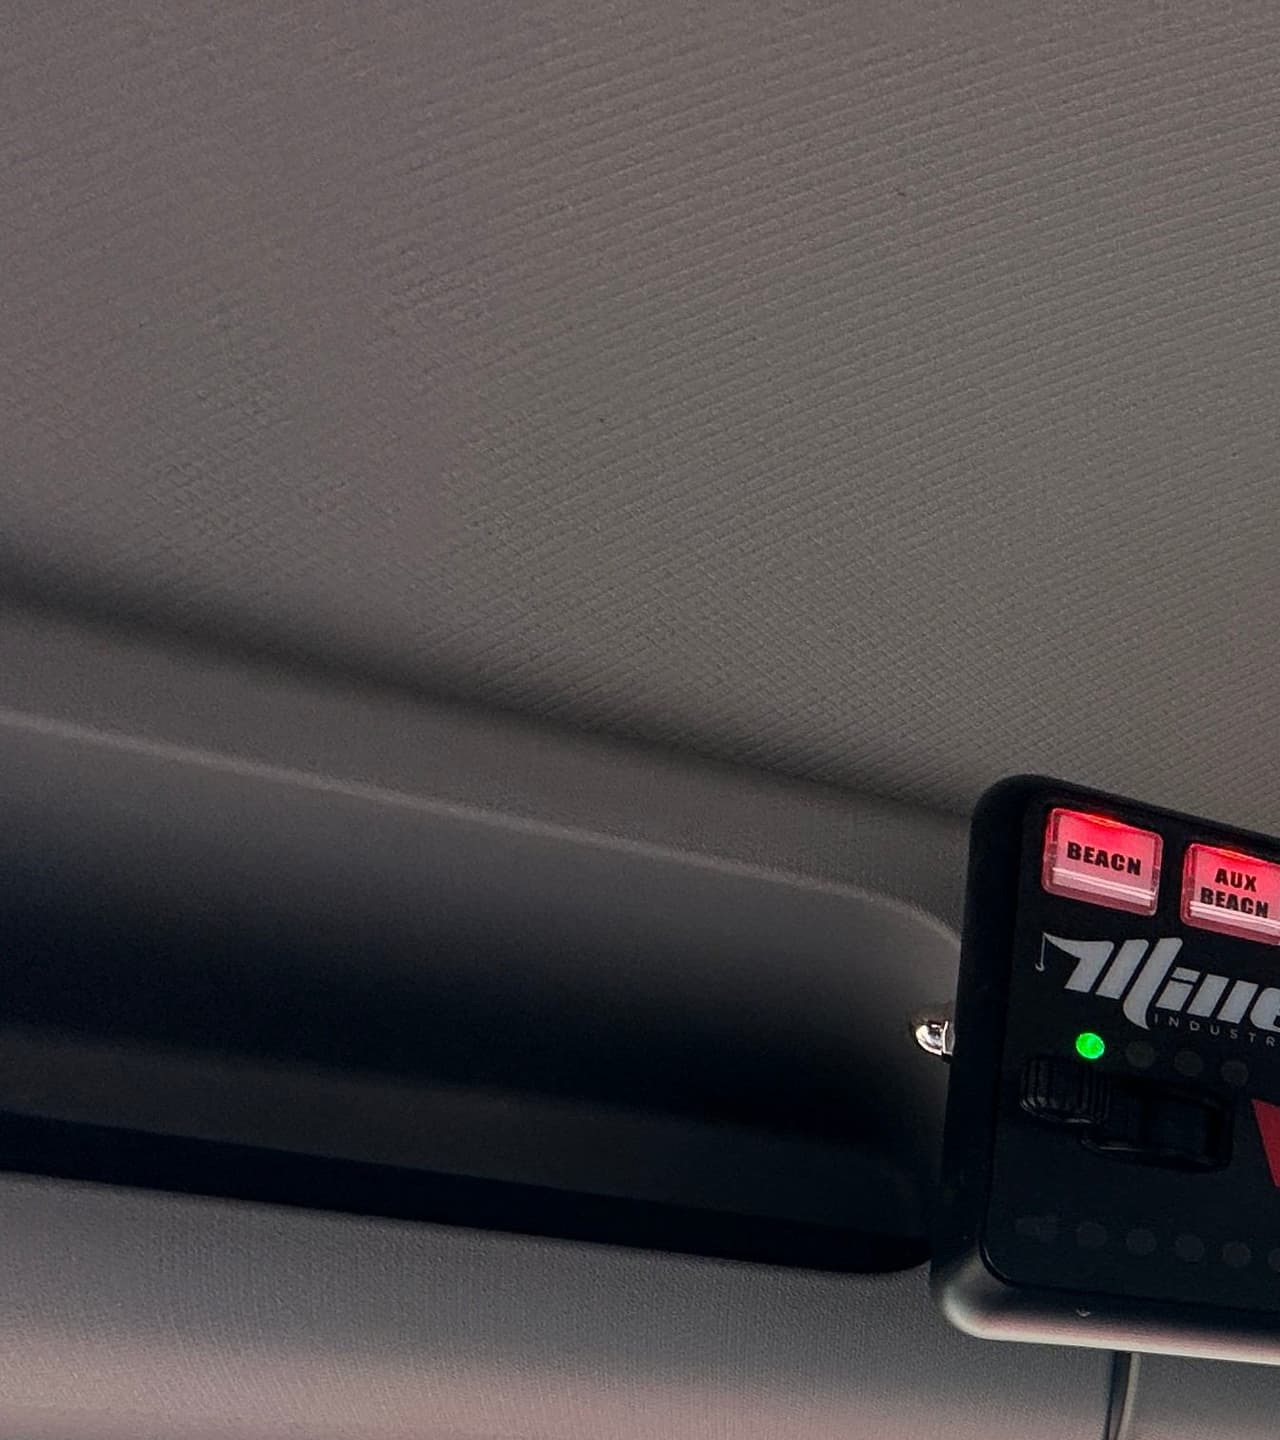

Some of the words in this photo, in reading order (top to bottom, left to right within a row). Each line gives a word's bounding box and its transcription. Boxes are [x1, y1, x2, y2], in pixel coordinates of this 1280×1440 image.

[1067, 841, 1142, 876] BEACN
[1215, 867, 1257, 892] AUX
[1200, 887, 1269, 918] BEACN
